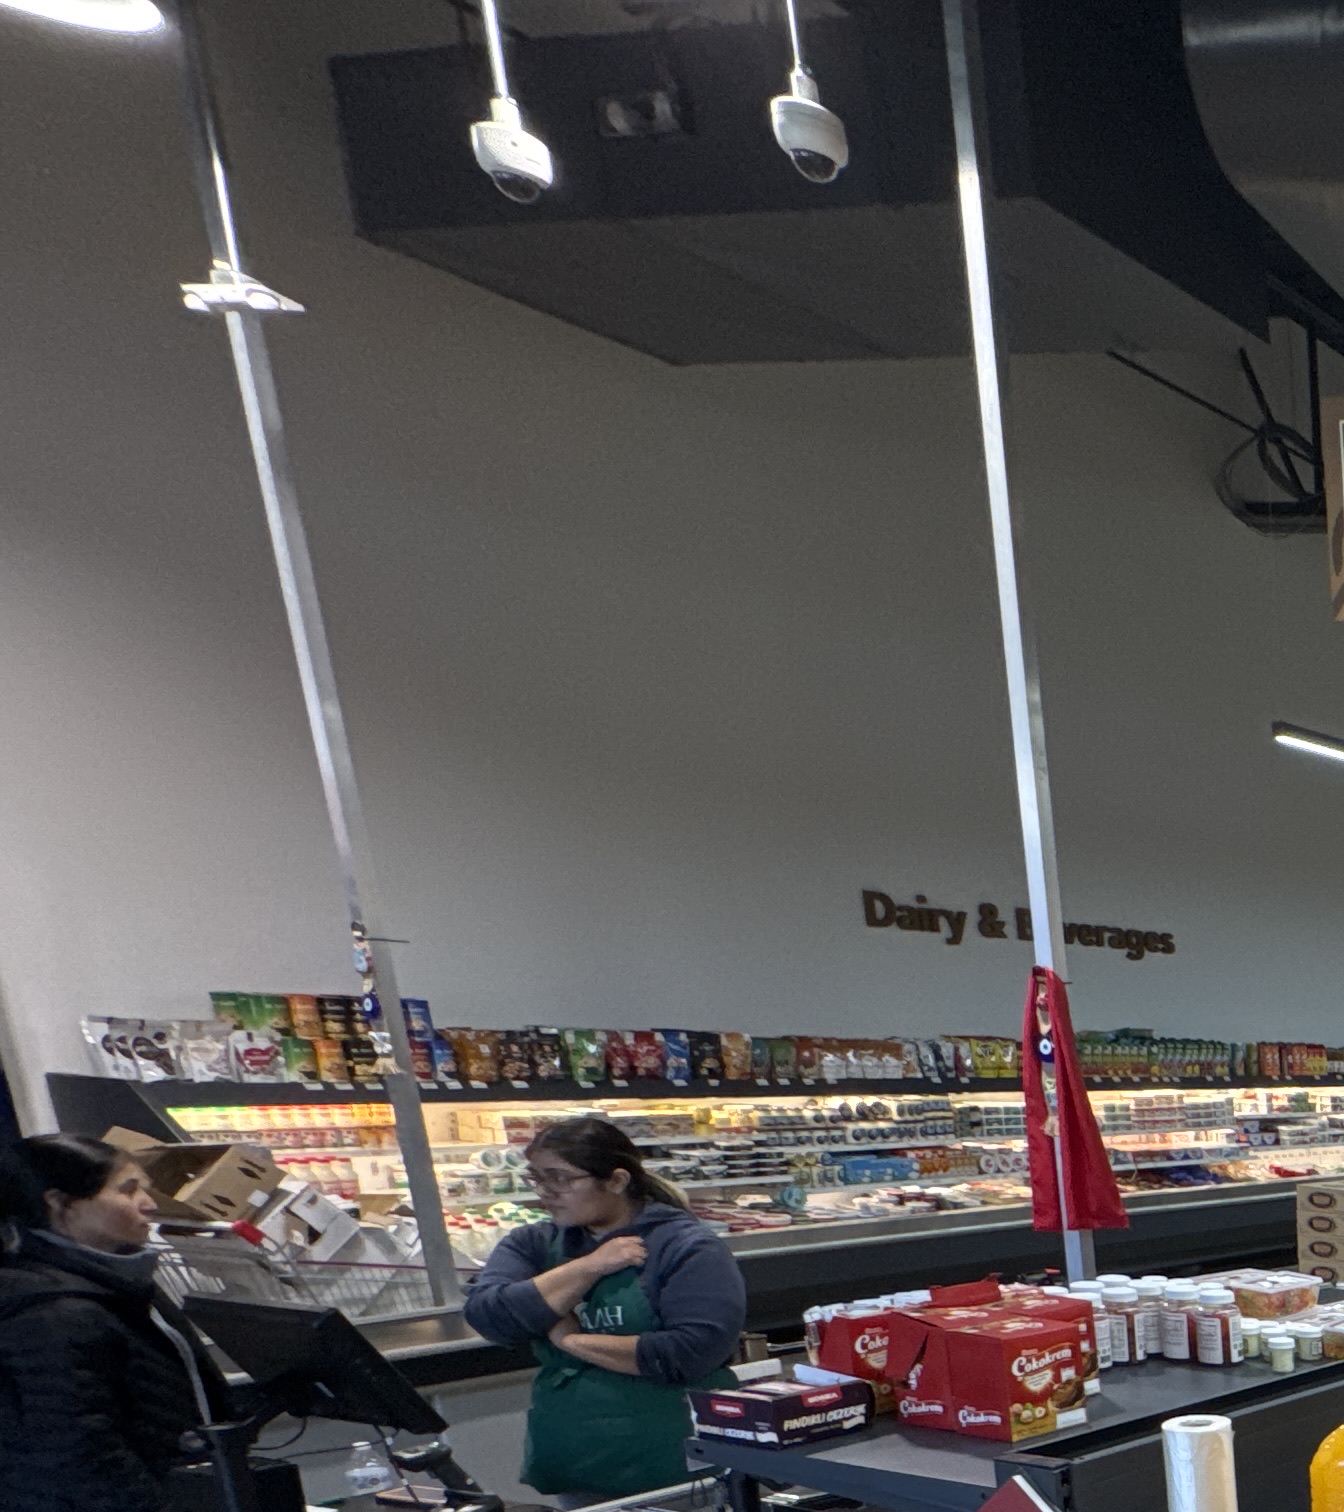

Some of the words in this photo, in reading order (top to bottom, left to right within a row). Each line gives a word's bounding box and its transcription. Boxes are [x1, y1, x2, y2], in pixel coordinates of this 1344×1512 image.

[862, 888, 968, 946] Dairy
[977, 902, 1008, 939] &
[1015, 906, 1177, 961] Bverages
